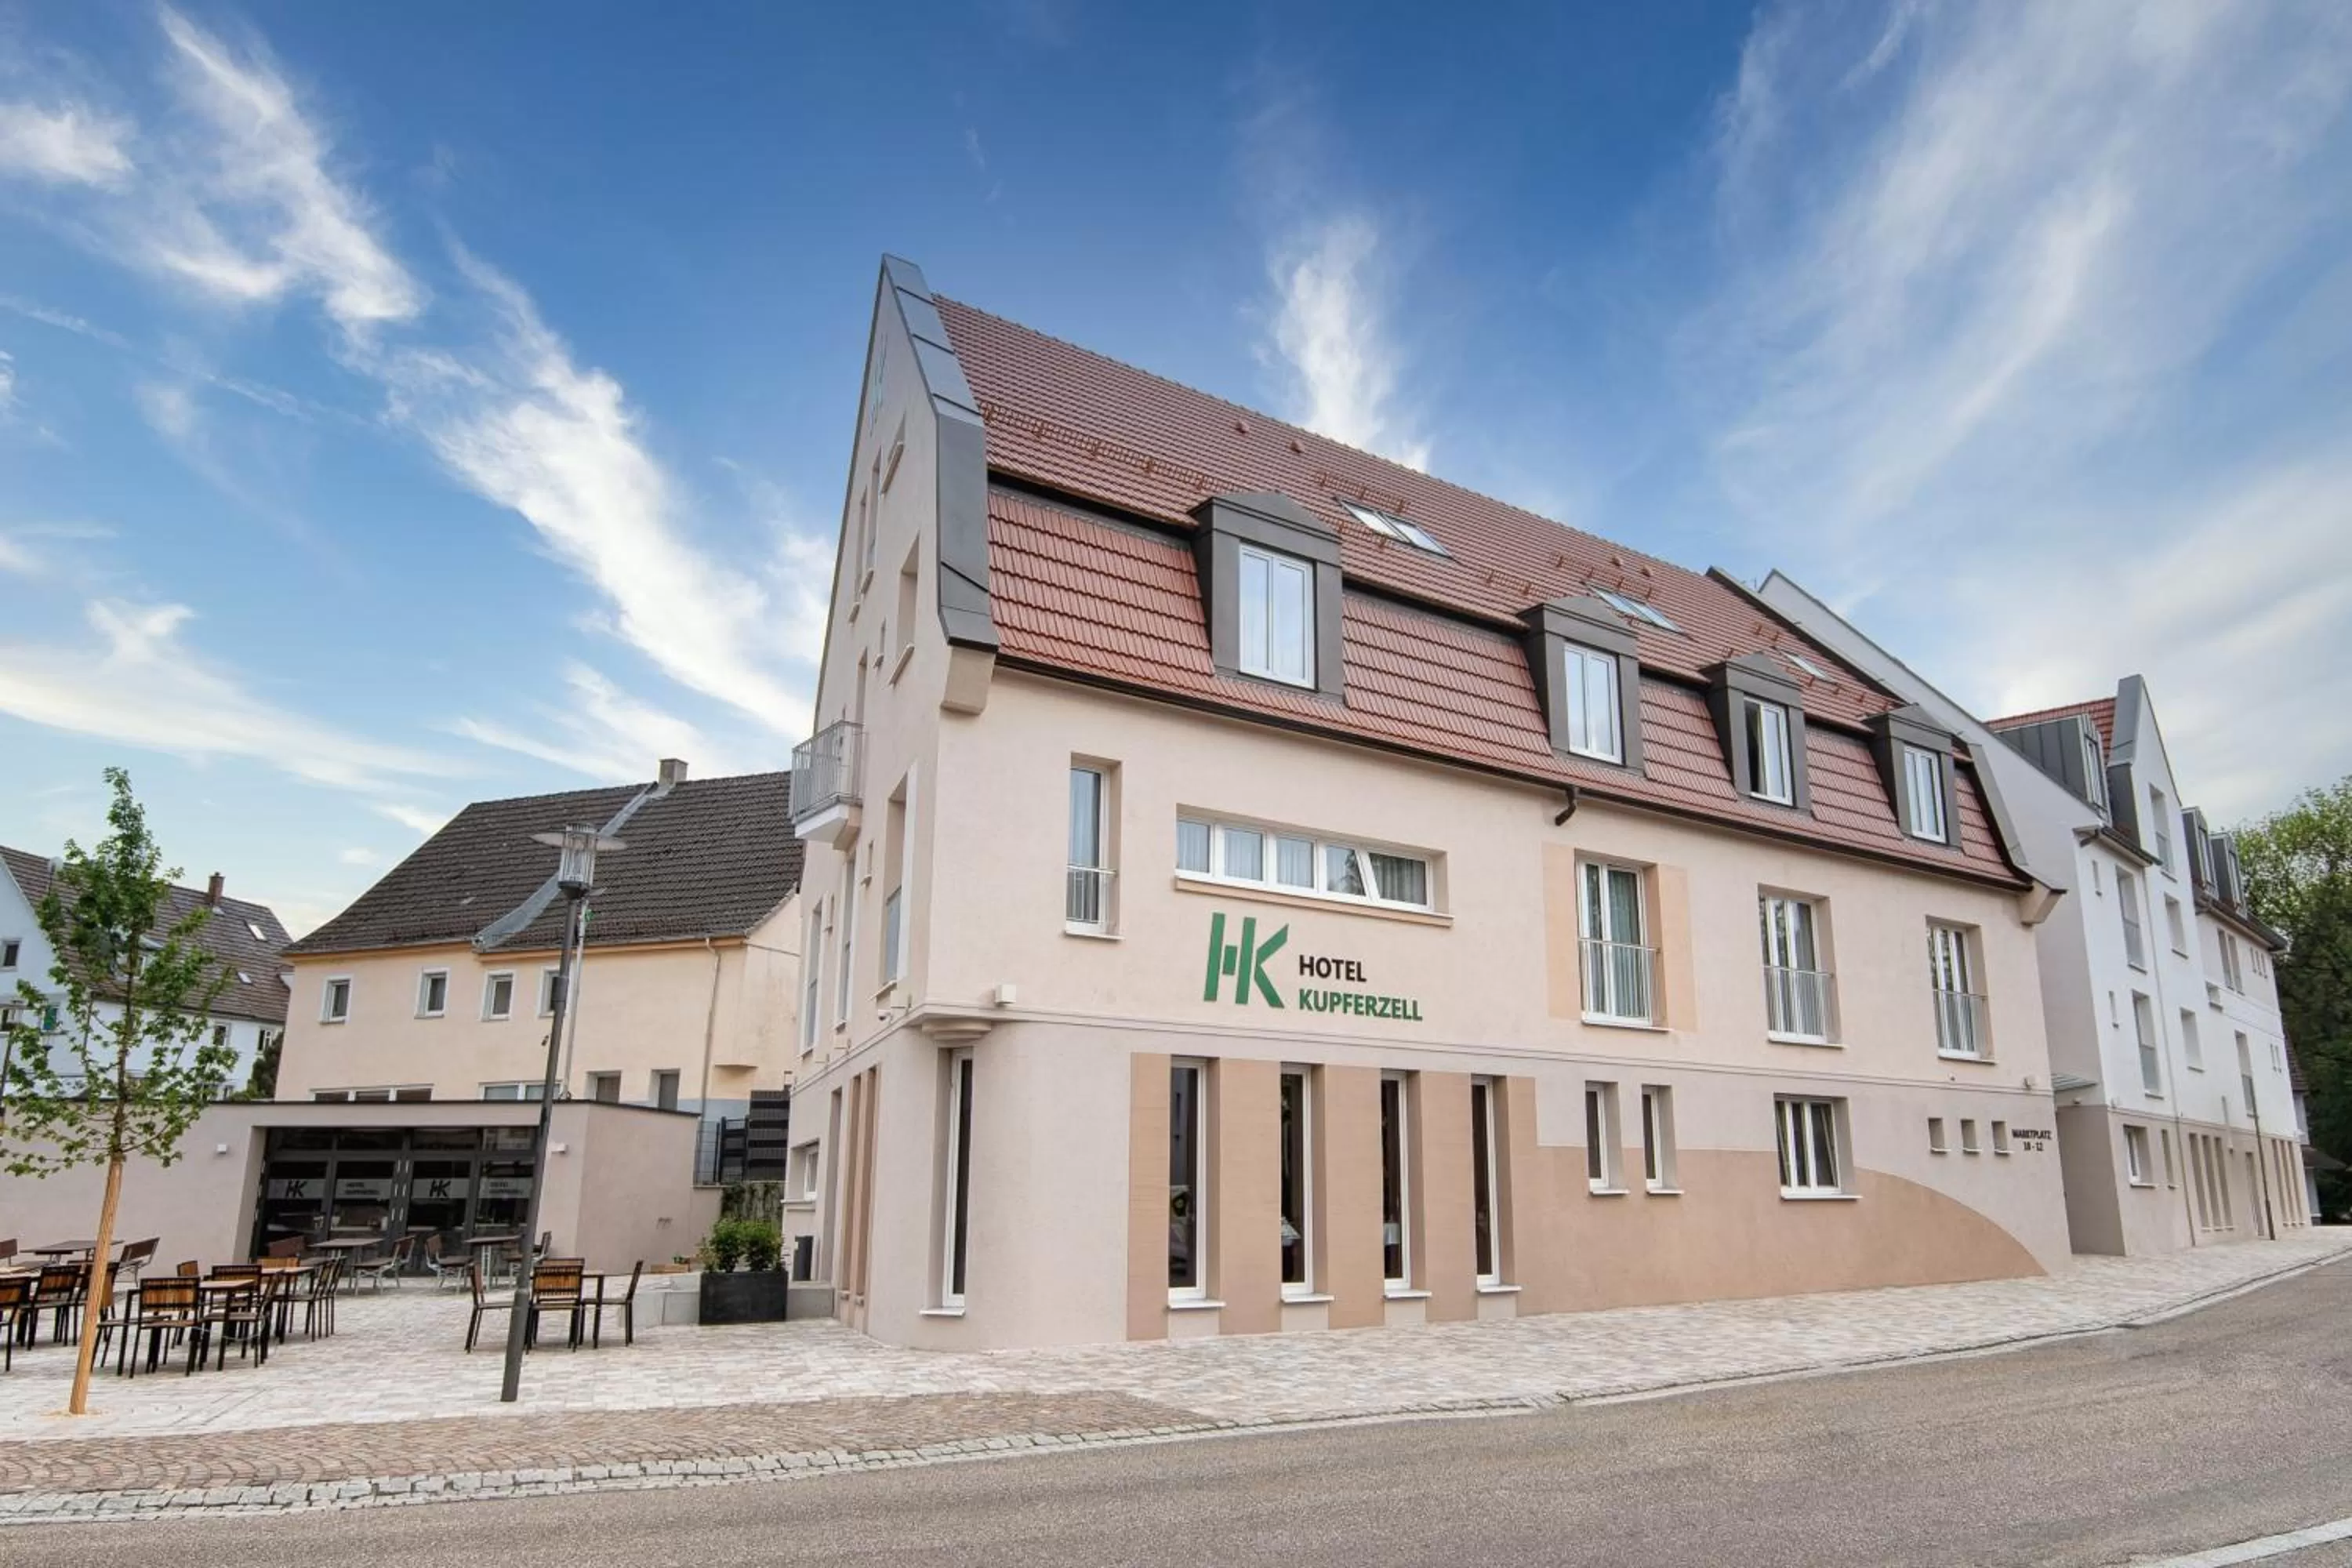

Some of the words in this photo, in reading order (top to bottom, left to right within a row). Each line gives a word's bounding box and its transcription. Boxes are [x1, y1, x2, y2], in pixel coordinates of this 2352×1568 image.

[1203, 912, 1289, 1009] HK
[1299, 954, 1367, 982] HOTEL
[1298, 989, 1423, 1021] KUPFERZELL
[285, 1180, 307, 1198] HK
[429, 1179, 452, 1197] HK
